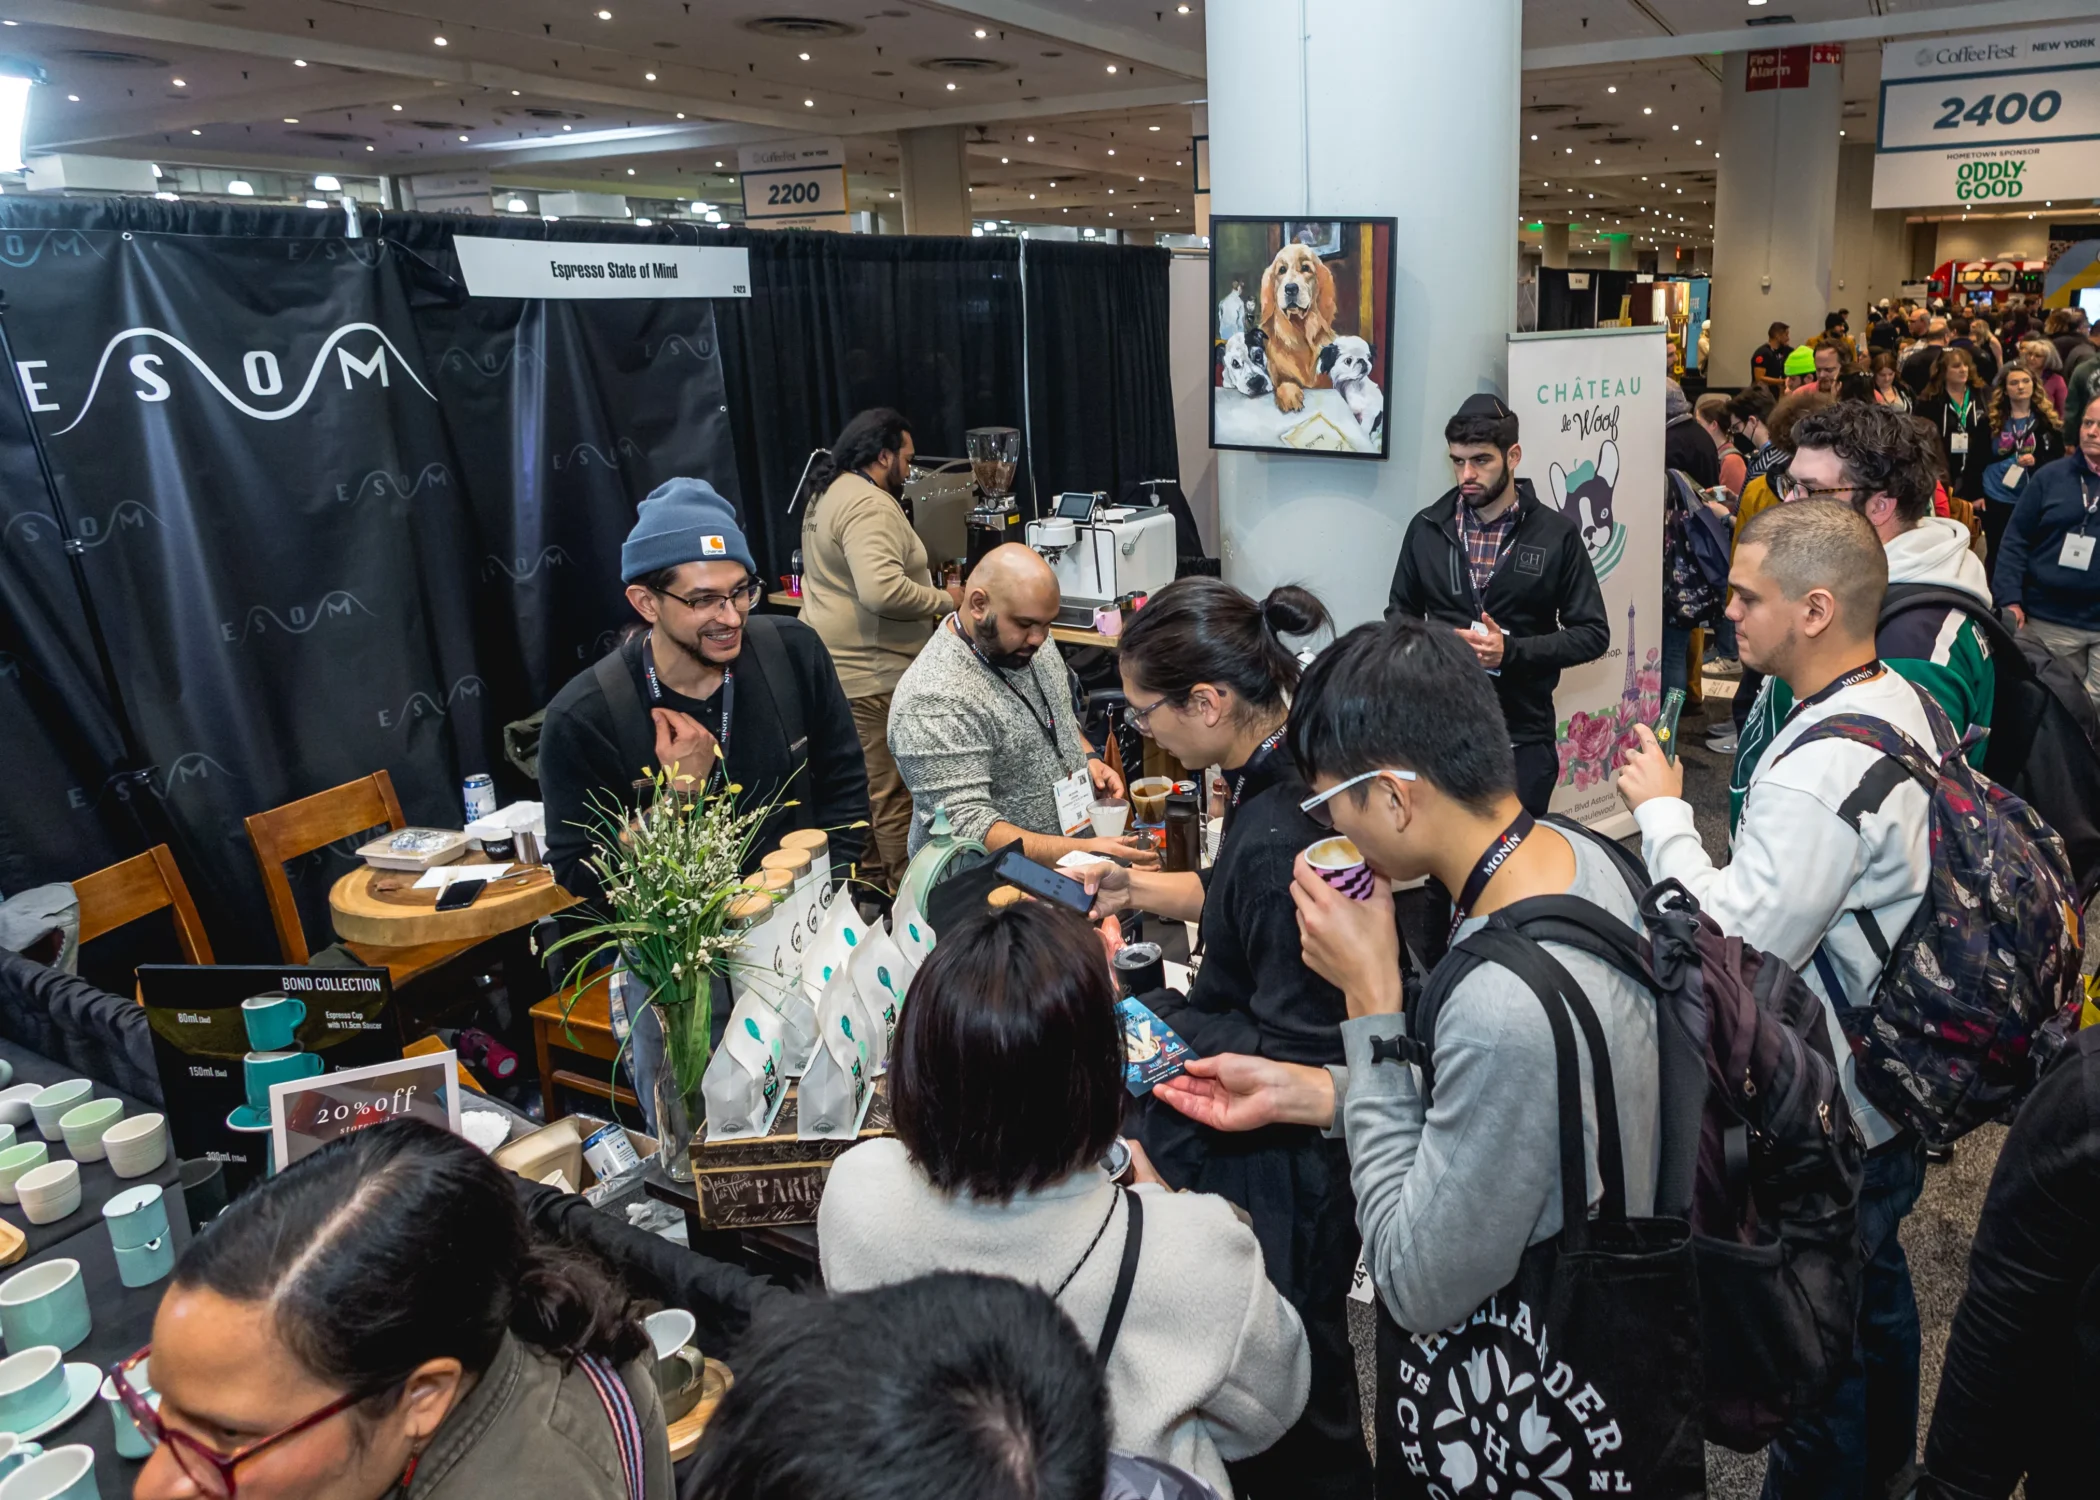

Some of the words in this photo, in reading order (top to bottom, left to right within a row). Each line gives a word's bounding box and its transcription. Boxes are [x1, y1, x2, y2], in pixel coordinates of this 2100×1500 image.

[2032, 41, 2060, 52] NEW
[2064, 38, 2095, 49] YORK
[1750, 55, 1775, 66] Fire
[1750, 66, 1791, 78] Alarm
[1933, 89, 2062, 130] 2400
[1947, 151, 1997, 160] HOMETOWN
[2000, 148, 2040, 157] SPONSOR
[1958, 160, 2026, 182] ODDLY
[768, 182, 820, 205] 2200
[1957, 179, 2023, 200] GOOD
[551, 261, 605, 281] Espresso
[608, 262, 637, 279] State
[640, 263, 651, 279] of
[653, 263, 678, 279] Mind
[733, 285, 746, 294] 2423
[17, 345, 390, 413] ESOM
[1537, 376, 1641, 404] CHÂTEAU
[1561, 414, 1571, 432] le
[1573, 405, 1620, 441] Woof
[22, 510, 144, 543] SOM
[1520, 551, 1541, 566] CH
[220, 599, 351, 643] ESOM
[648, 667, 662, 699] MONIN
[1841, 667, 1874, 688] MONIN
[721, 711, 729, 743] MONIN
[1232, 775, 1246, 808] MONIN
[1483, 833, 1521, 876] MONIN
[282, 977, 313, 991] BOND
[315, 978, 382, 992] COLLECTION
[177, 1012, 199, 1024] 80ml
[325, 1010, 351, 1020] Espresso
[351, 1011, 364, 1021] Cup
[327, 1021, 340, 1029] with
[341, 1021, 361, 1029] 11.5cm
[362, 1021, 382, 1030] Saucer
[1165, 1041, 1180, 1053] 64
[188, 1066, 214, 1077] 150ml
[205, 1151, 231, 1162] 300ml
[771, 1205, 798, 1221] the
[1399, 1359, 1431, 1395] US
[1482, 1421, 1511, 1476] H
[1588, 1469, 1632, 1493] NL
